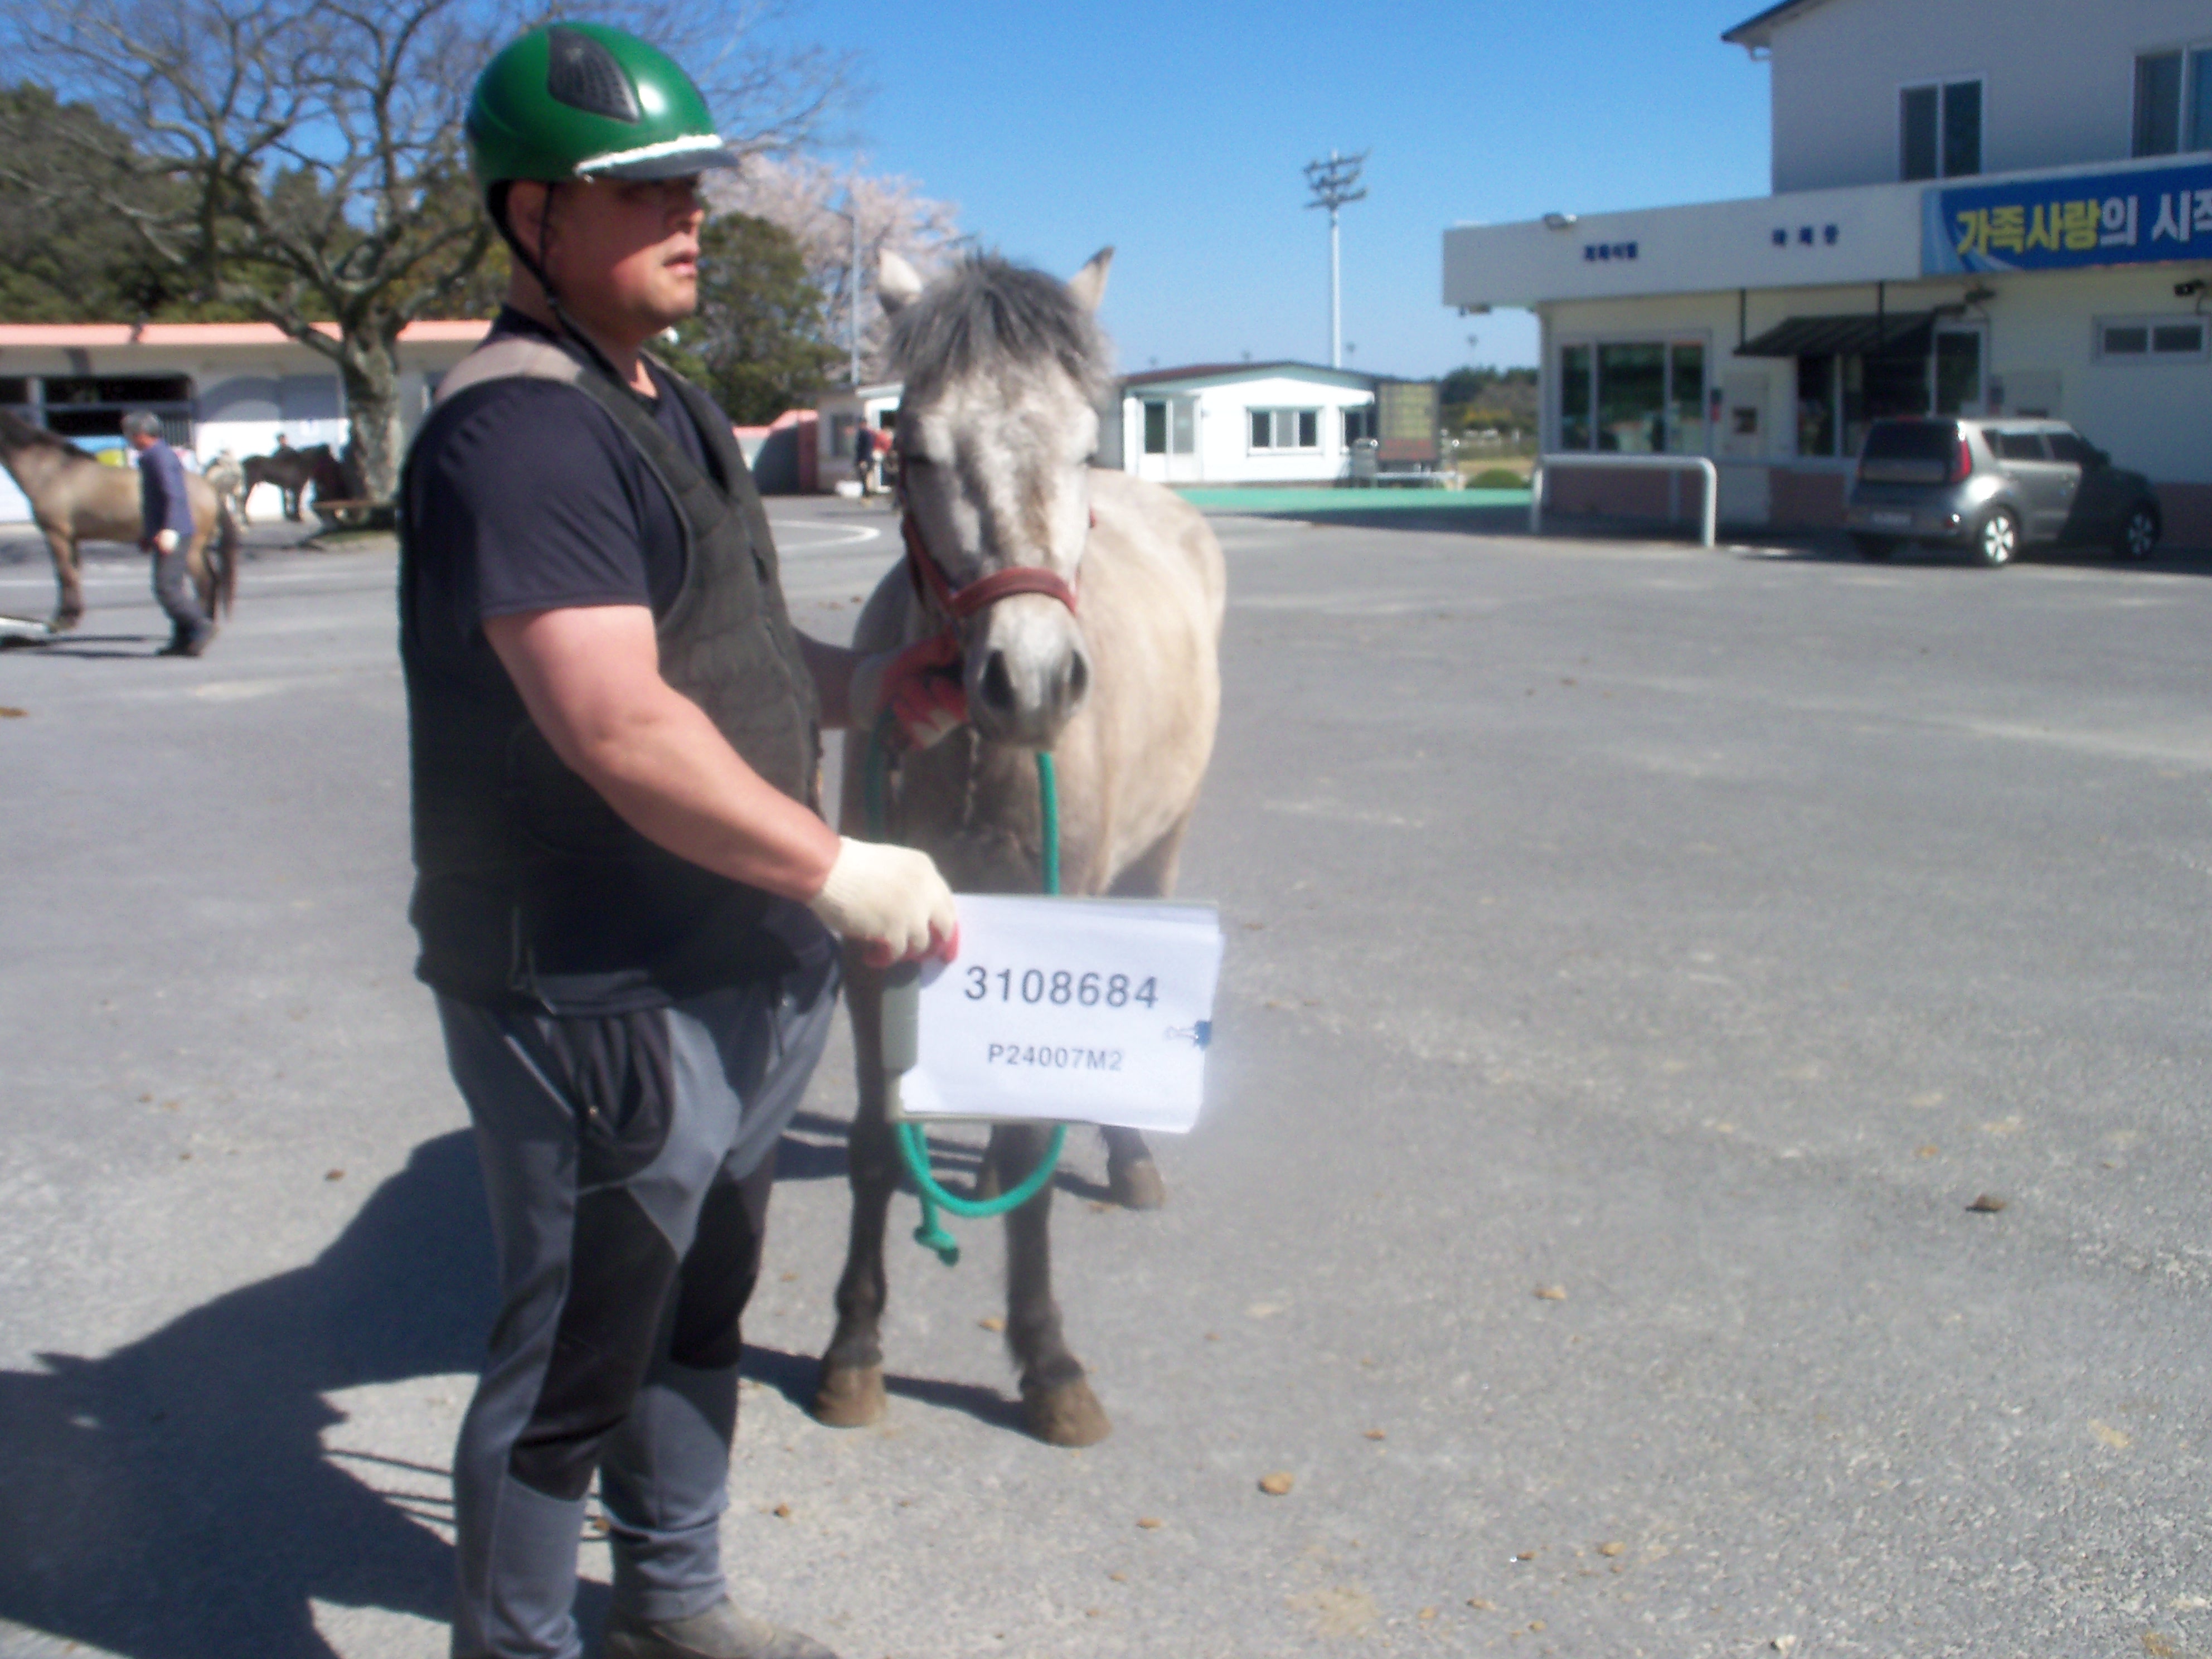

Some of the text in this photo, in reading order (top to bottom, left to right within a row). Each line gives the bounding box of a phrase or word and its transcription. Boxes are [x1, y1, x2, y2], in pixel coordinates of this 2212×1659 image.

[1956, 195, 2139, 255] 가족사랑의
[964, 966, 1159, 1008] 3108684
[989, 1044, 1123, 1071] P24007M2
